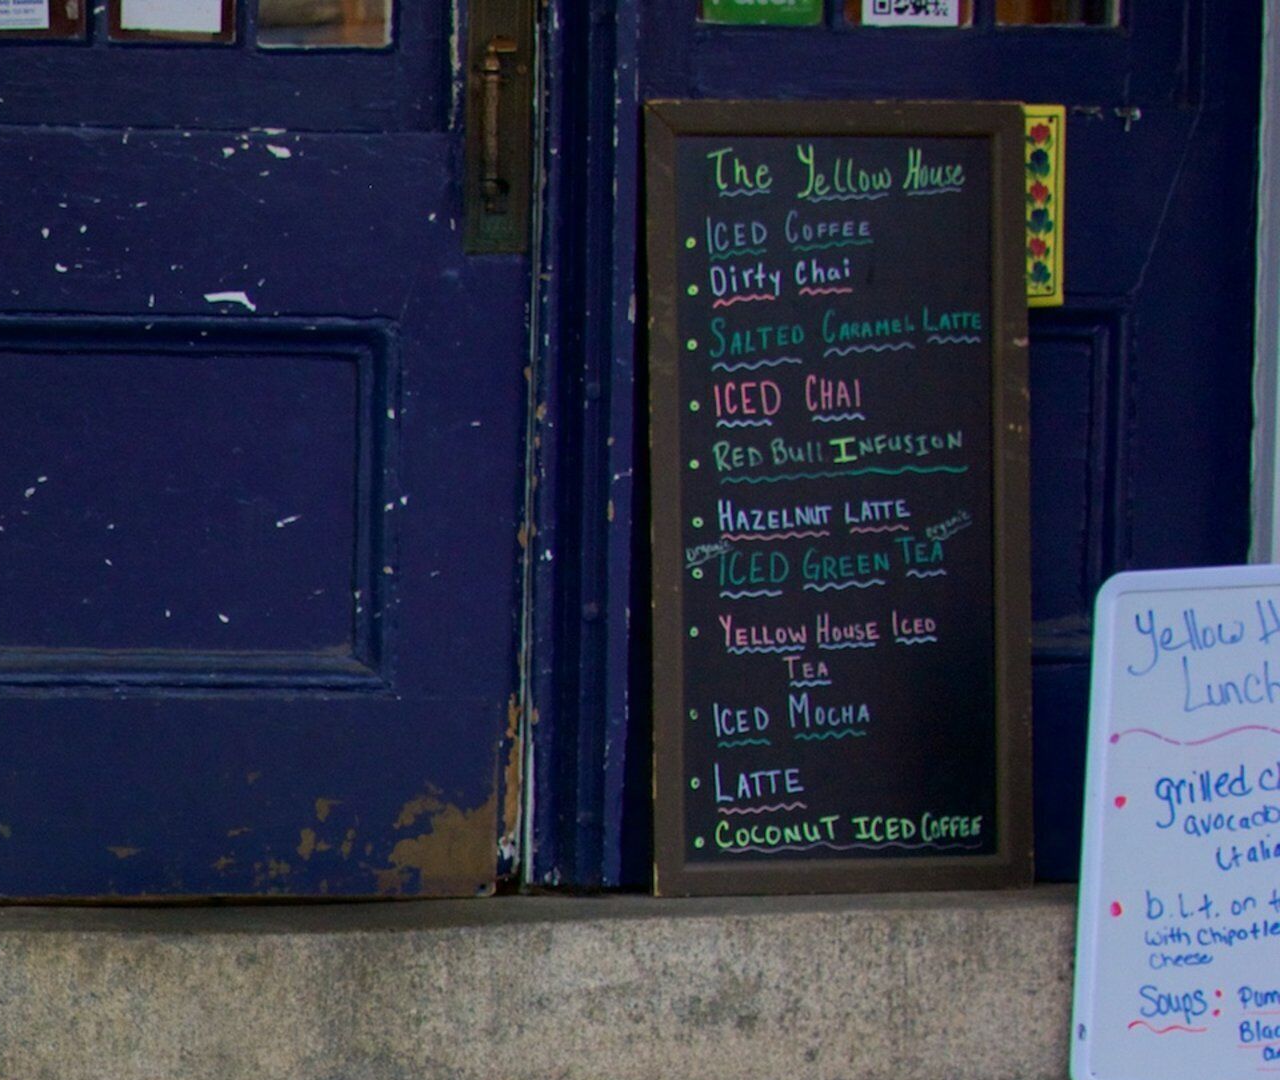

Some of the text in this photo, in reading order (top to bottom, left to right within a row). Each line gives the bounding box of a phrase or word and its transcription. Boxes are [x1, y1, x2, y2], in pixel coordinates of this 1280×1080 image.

[707, 144, 964, 197] The Yellow House
[706, 211, 871, 252] ICED COFFEE
[710, 258, 851, 297] Dirty Chai
[710, 317, 805, 358] SALTED
[922, 306, 981, 331] LATTE
[714, 375, 861, 416] ICED CHAI
[713, 440, 761, 471] RED
[829, 431, 962, 463] INFUSION
[718, 500, 911, 532] HAZELNUT LATTE
[719, 537, 943, 586] ICED GREEN TEA
[719, 610, 937, 646] YELLOW HOUSE ICED
[1127, 609, 1244, 676] Yellow
[782, 656, 829, 678] TEA
[713, 693, 870, 737] ICED MOCHA
[713, 763, 804, 803] LATTE
[1155, 764, 1252, 829] grilled
[715, 812, 982, 847] COCONUT ICED COFFEE
[1231, 897, 1256, 915] on
